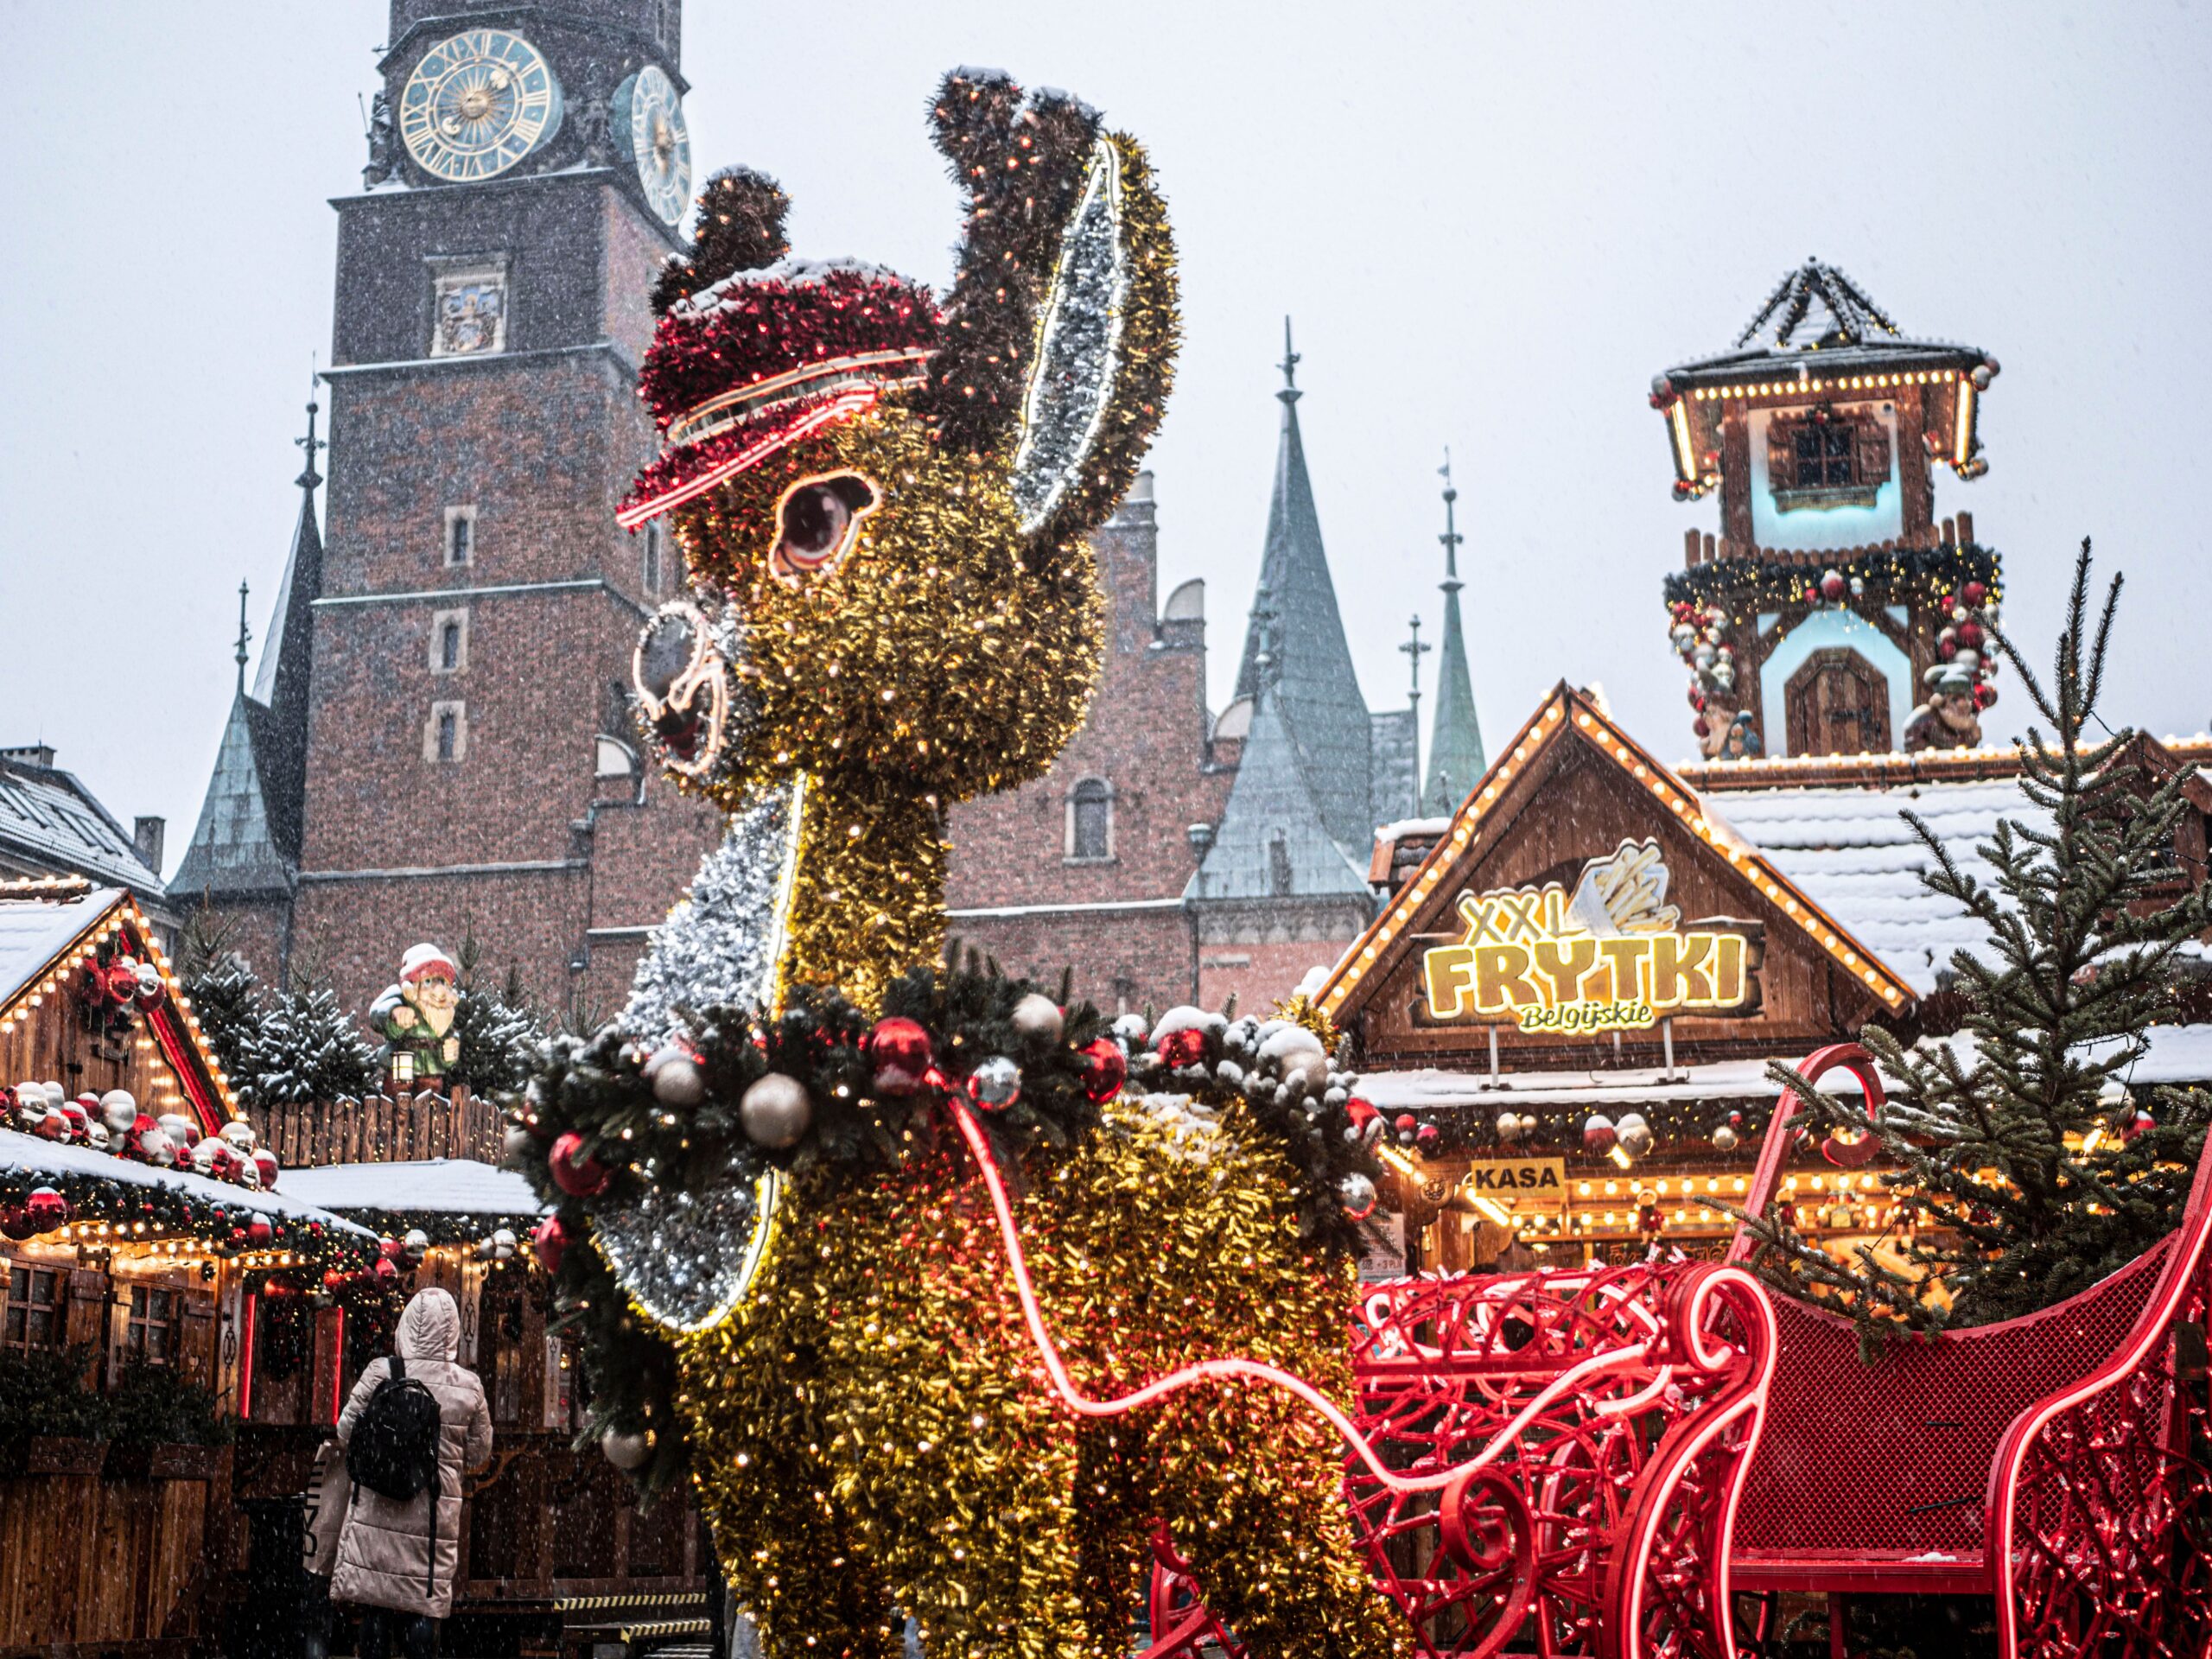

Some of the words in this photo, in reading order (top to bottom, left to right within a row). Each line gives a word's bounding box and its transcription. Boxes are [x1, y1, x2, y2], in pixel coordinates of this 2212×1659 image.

[1459, 891, 1586, 946] XXL
[1426, 934, 1744, 1016] FRYTKI
[1520, 1001, 1653, 1030] Belgijskie
[1475, 1166, 1559, 1189] KASA
